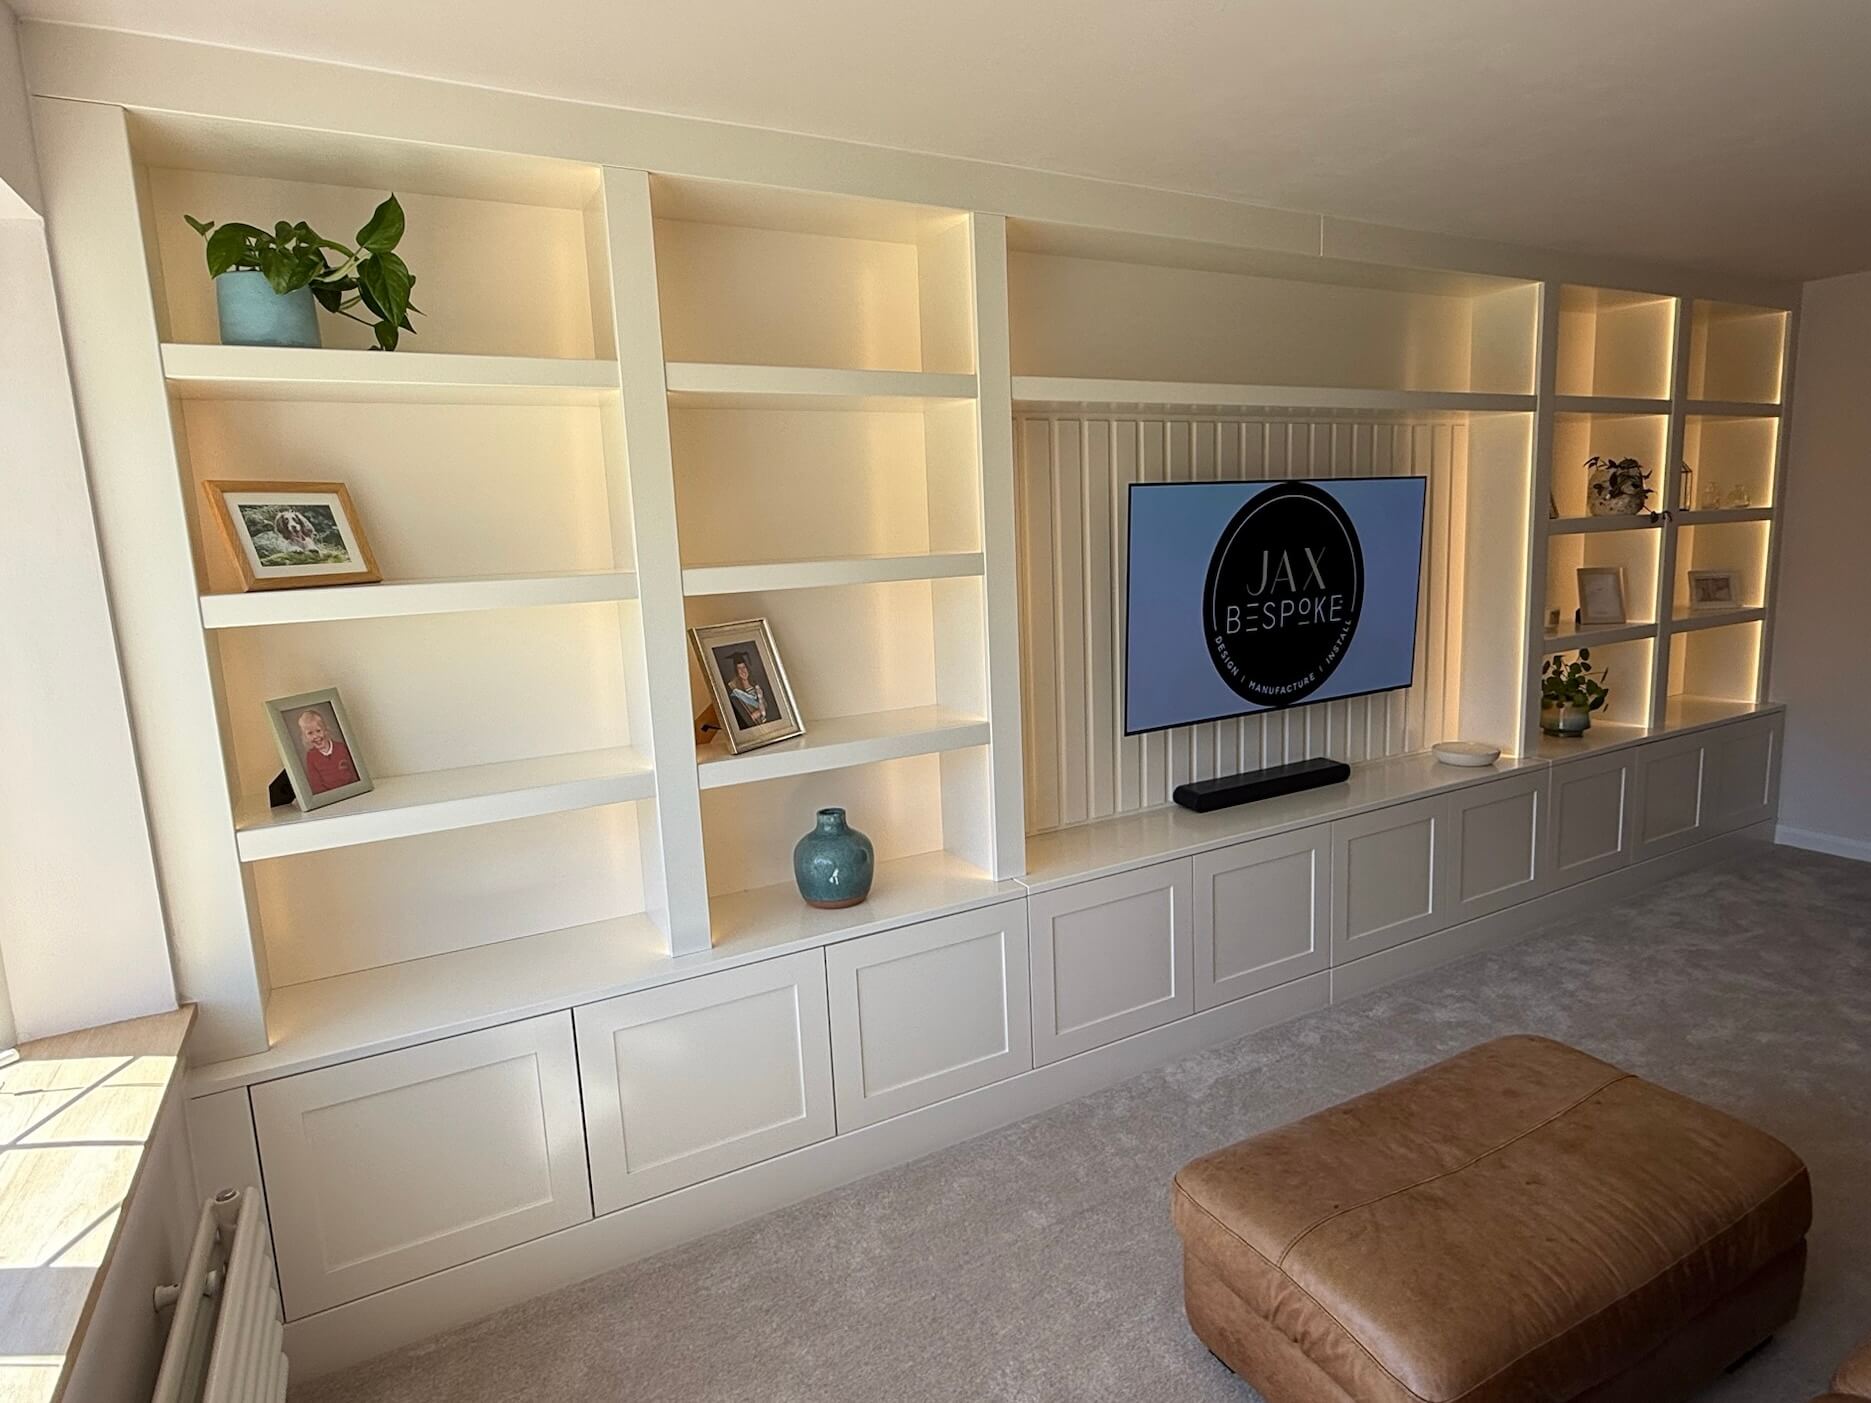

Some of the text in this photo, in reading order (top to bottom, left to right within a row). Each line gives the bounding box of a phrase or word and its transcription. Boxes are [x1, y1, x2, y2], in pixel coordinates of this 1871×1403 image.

[1246, 546, 1326, 596] JAX
[1226, 594, 1343, 634] BESPOKE
[1215, 619, 1352, 695] DESIGN MANUFACTURE INSTALL
